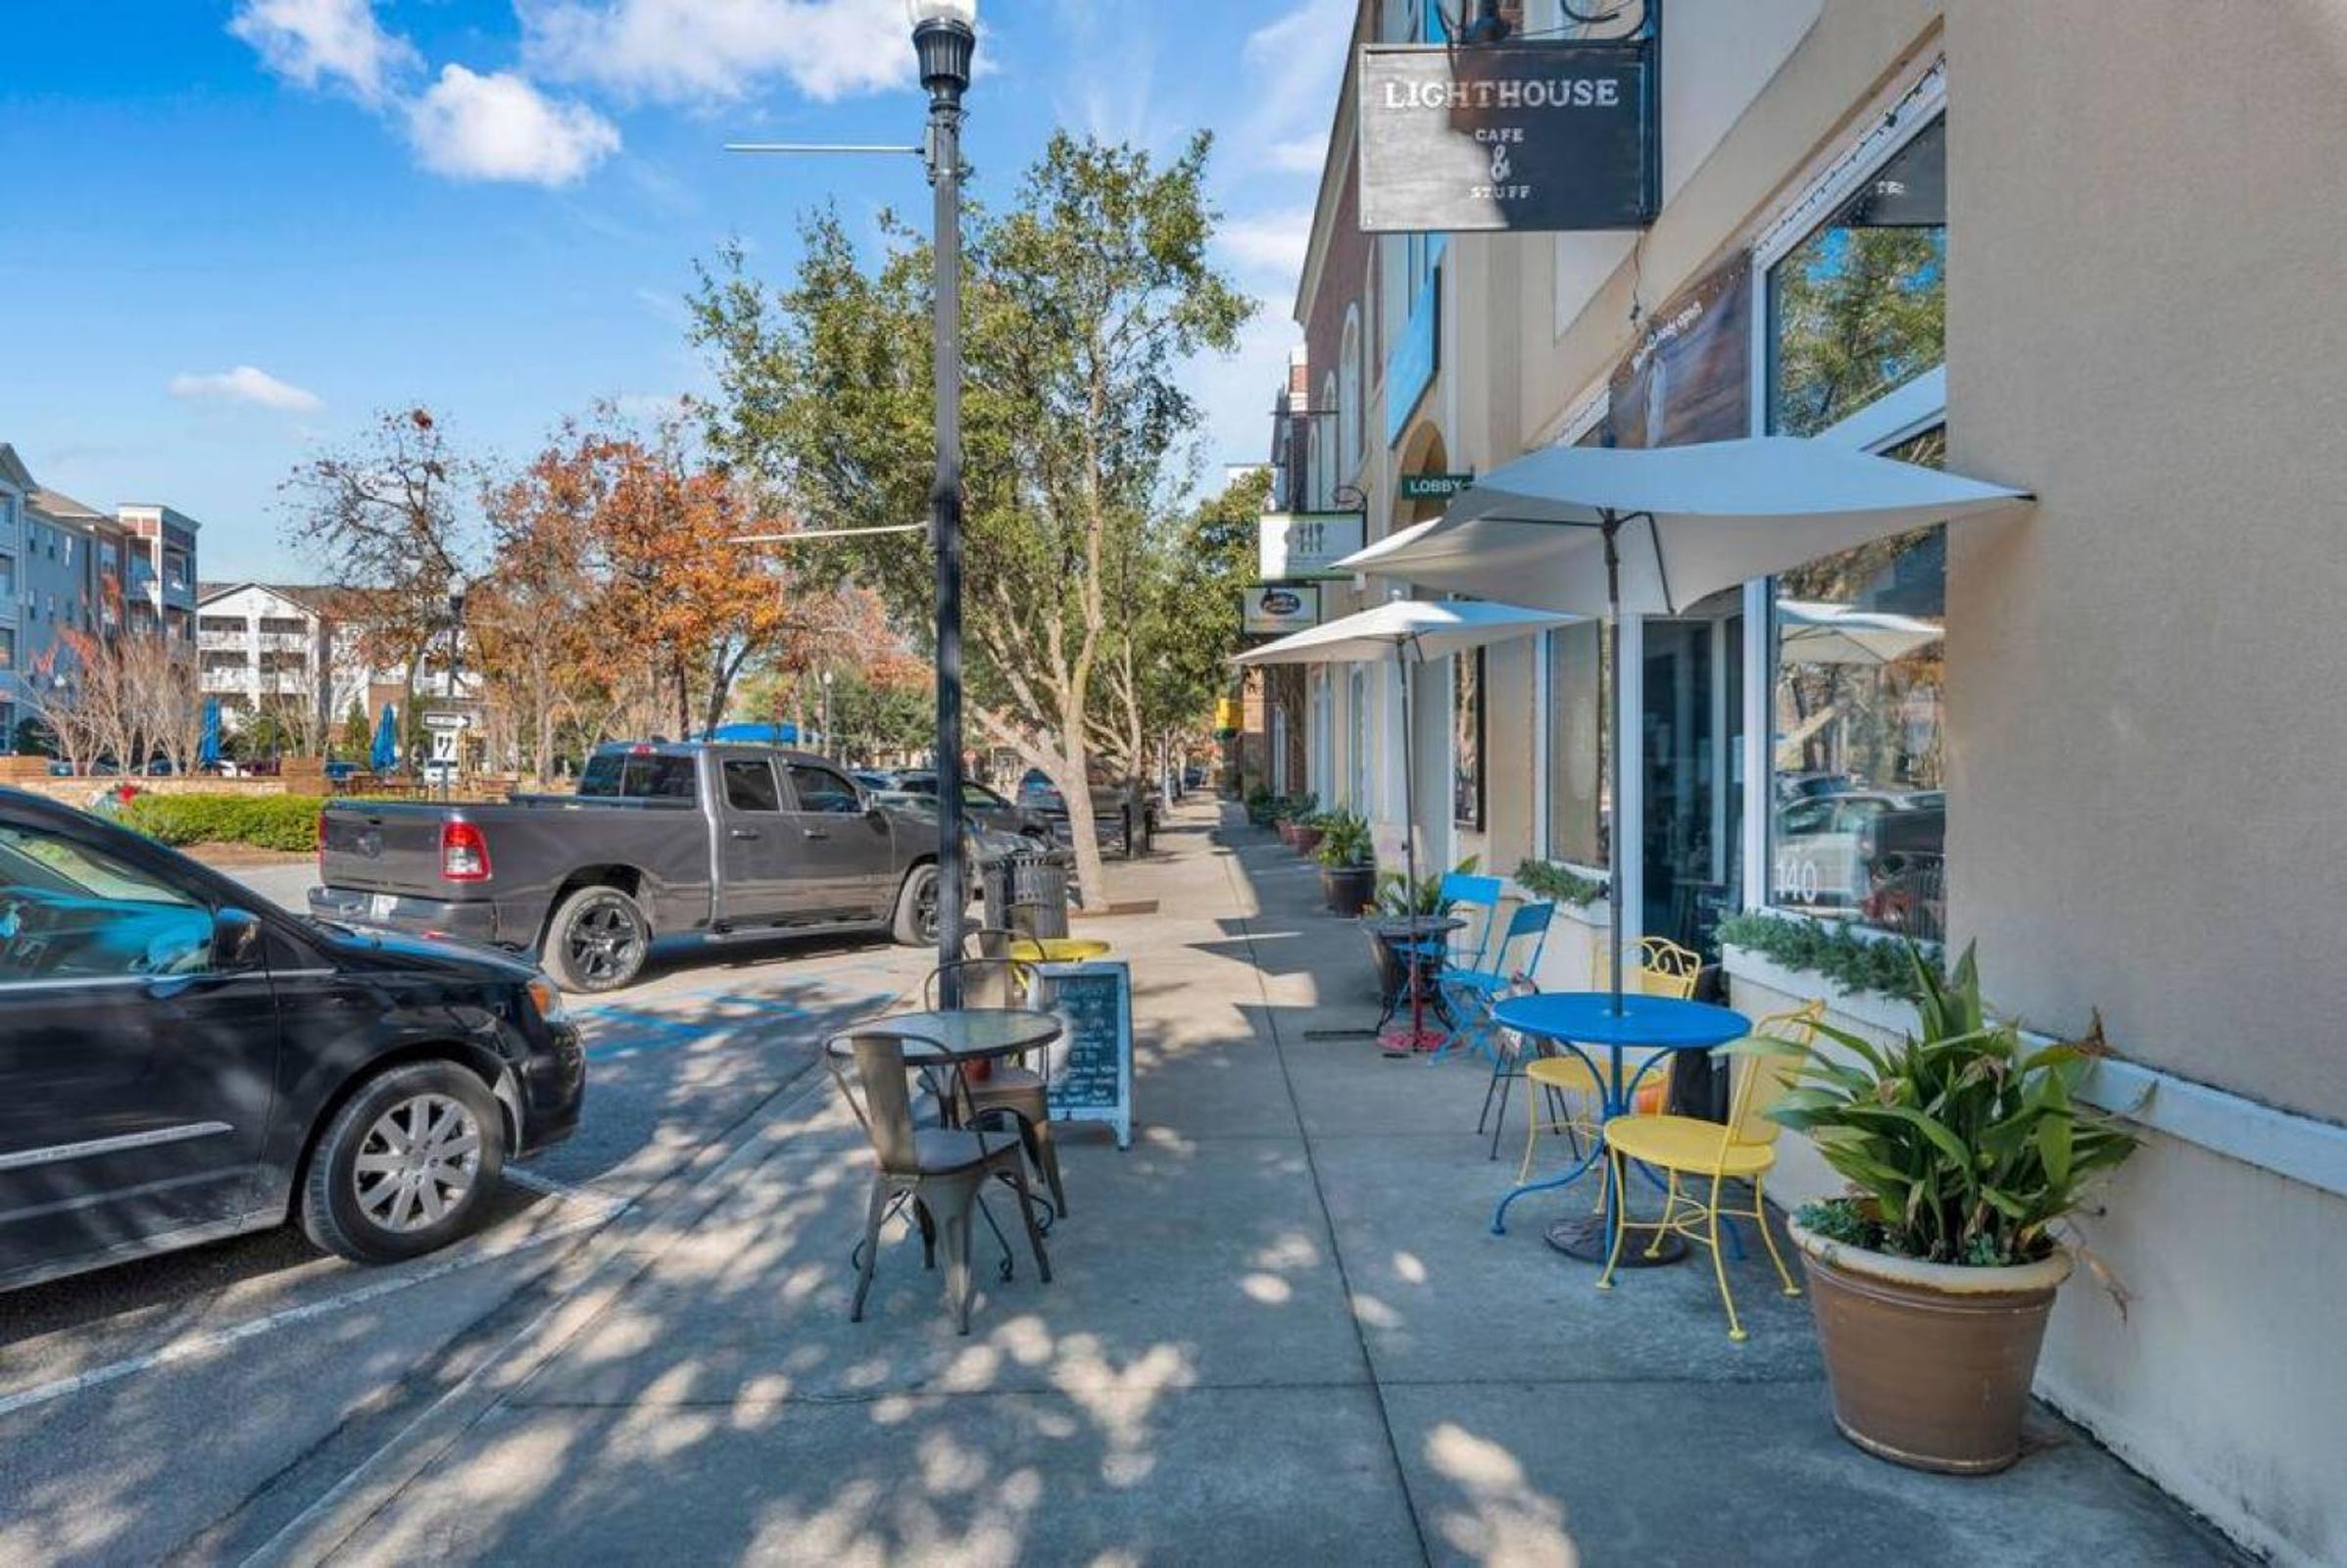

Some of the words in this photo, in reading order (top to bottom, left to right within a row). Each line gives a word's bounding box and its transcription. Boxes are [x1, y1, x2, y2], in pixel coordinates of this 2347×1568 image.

[1385, 78, 1620, 109] LIGHTHOUSE
[1475, 127, 1524, 143] CAFE
[1491, 144, 1510, 182] &
[1470, 185, 1531, 199] STUFF
[1409, 478, 1462, 494] LOBBY
[1775, 859, 1817, 904] 140
